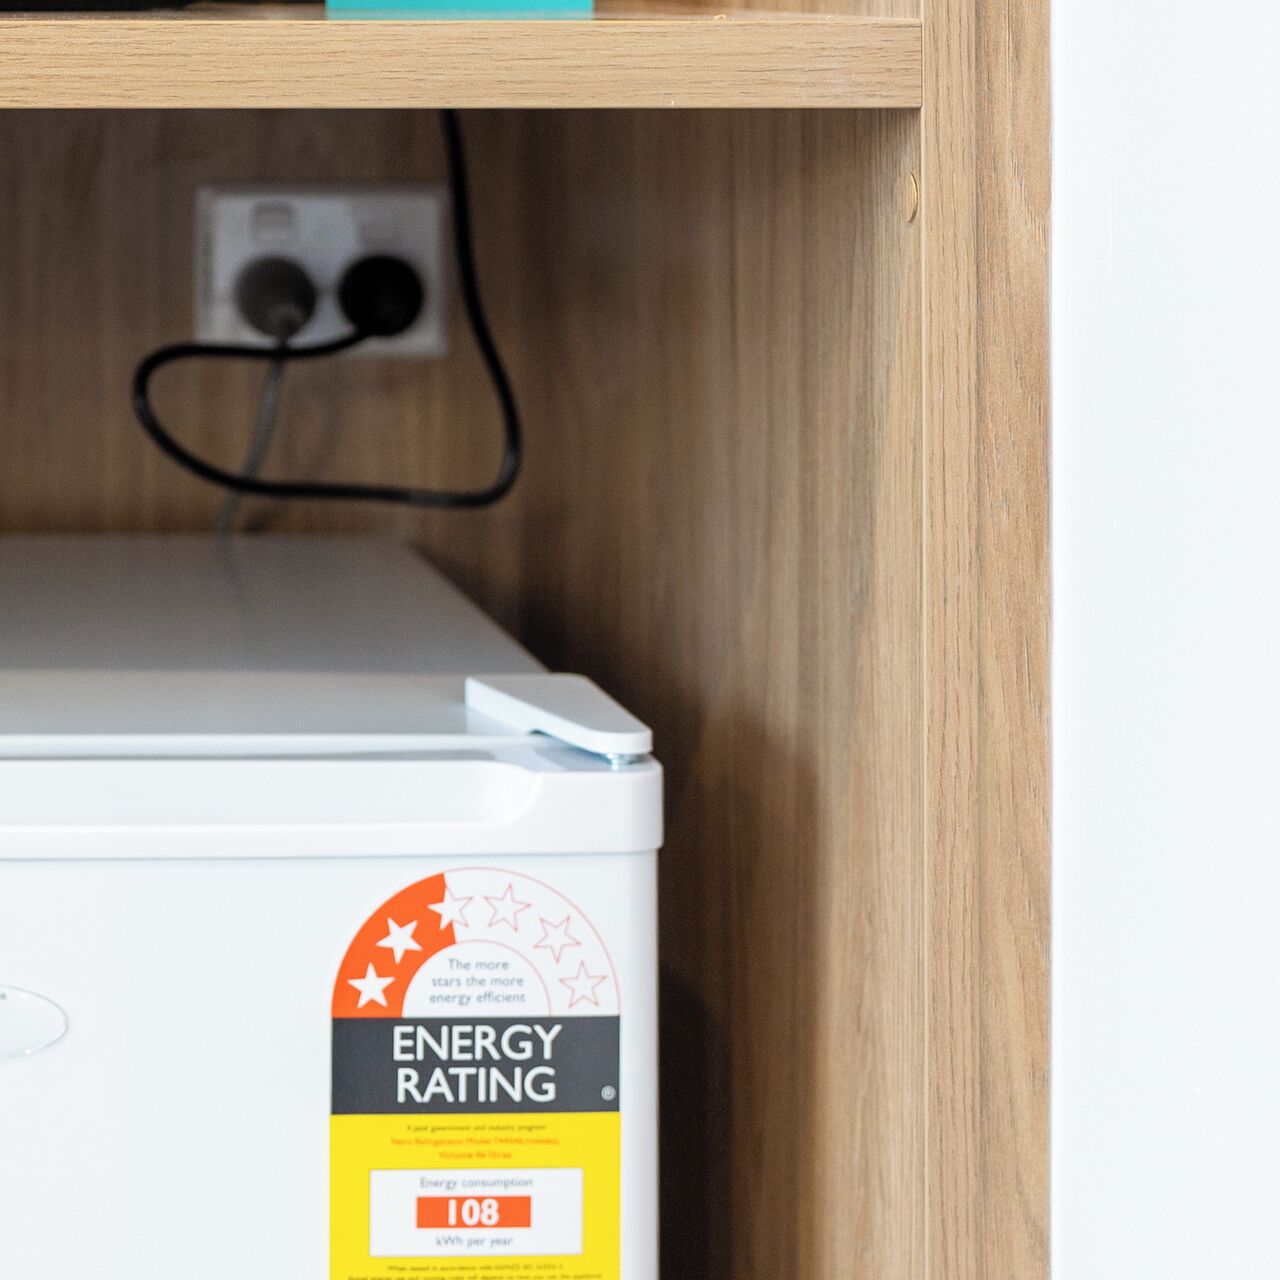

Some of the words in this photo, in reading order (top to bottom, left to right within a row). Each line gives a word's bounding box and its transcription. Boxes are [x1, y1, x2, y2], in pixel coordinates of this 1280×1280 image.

[447, 958, 471, 971] The
[475, 961, 510, 971] more
[431, 976, 464, 987] stars
[466, 975, 487, 987] the
[490, 976, 524, 987] more
[429, 993, 472, 1006] energy
[475, 991, 526, 1004] efficient
[392, 1023, 563, 1062] ENERGY
[396, 1066, 557, 1104] RATING
[419, 1176, 458, 1190] Energy
[460, 1176, 533, 1190] consumption
[447, 1198, 500, 1227] 108
[435, 1235, 464, 1247] kWh
[467, 1237, 487, 1249] per
[489, 1236, 514, 1249] year
